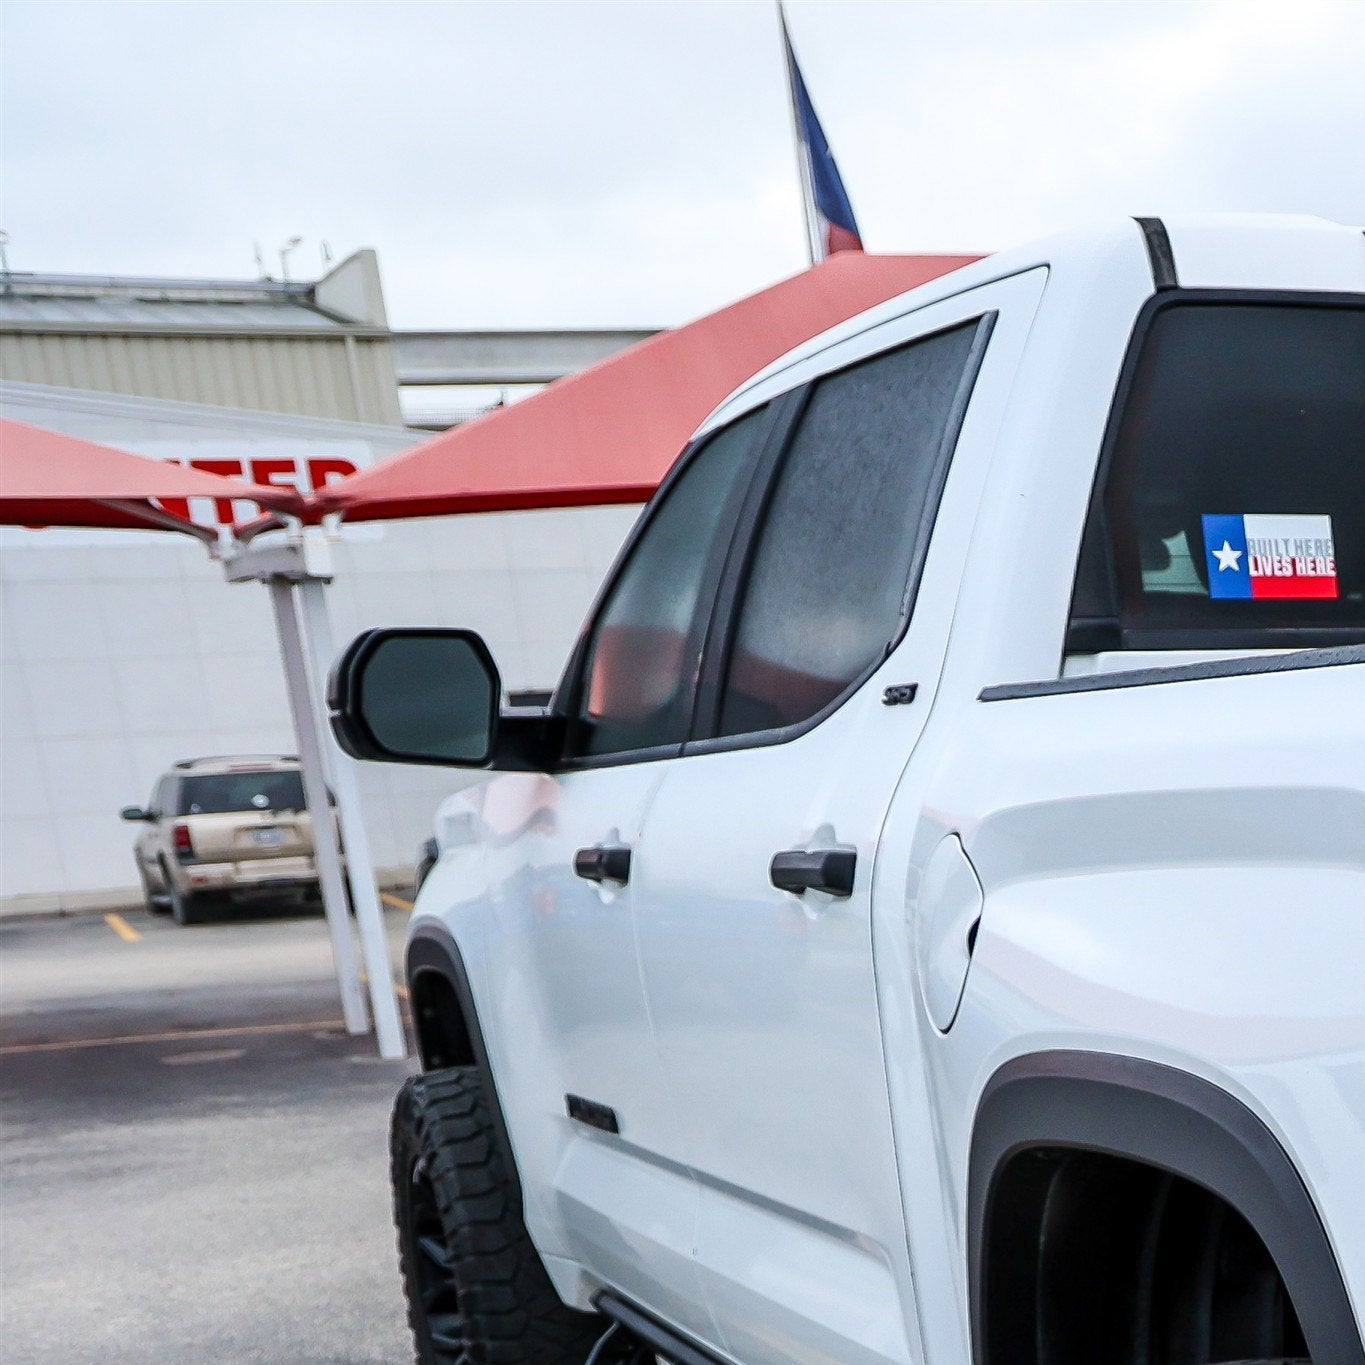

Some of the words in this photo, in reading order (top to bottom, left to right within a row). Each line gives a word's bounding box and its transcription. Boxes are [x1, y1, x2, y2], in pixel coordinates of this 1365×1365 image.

[1293, 538, 1333, 557] HERE
[1249, 556, 1292, 577] LIVES
[1295, 556, 1337, 577] HERE
